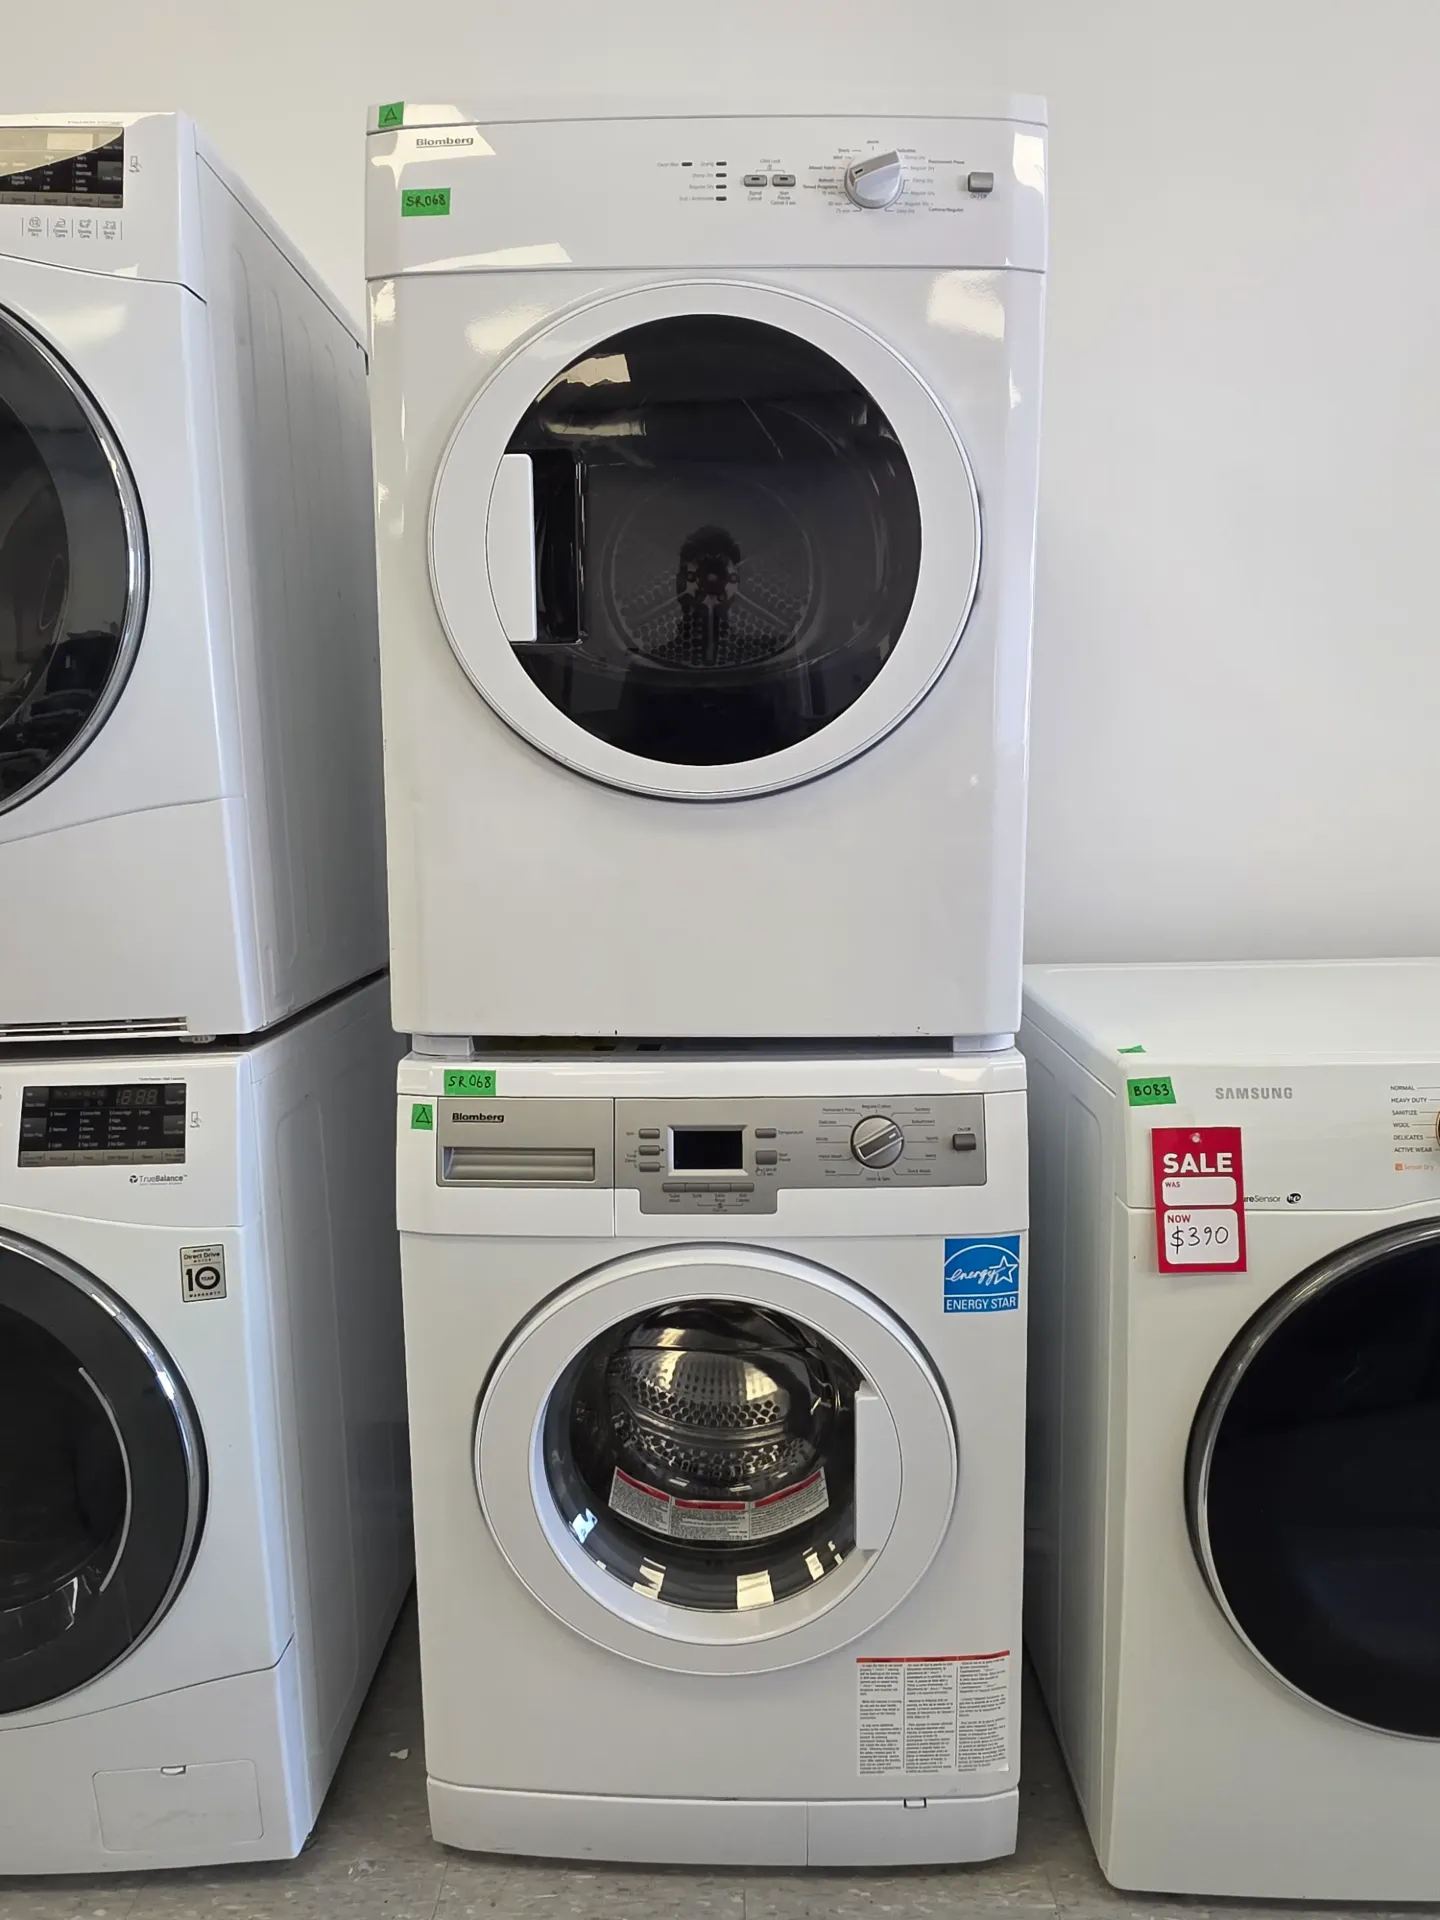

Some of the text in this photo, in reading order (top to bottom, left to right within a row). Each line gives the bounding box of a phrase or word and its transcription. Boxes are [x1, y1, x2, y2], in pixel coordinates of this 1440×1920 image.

[416, 137, 474, 146] Blomberg
[406, 194, 446, 208] SR068
[1134, 1086, 1170, 1096] B083
[1216, 1087, 1292, 1100] SAMSUNG
[452, 1112, 504, 1122] Blomberg
[1163, 1152, 1233, 1173] SALE
[1168, 1214, 1191, 1223] NOW
[1170, 1226, 1228, 1254] $390
[186, 1266, 220, 1291] 10
[946, 1268, 998, 1286] energy
[946, 1296, 1016, 1310] ENERGY STAR
